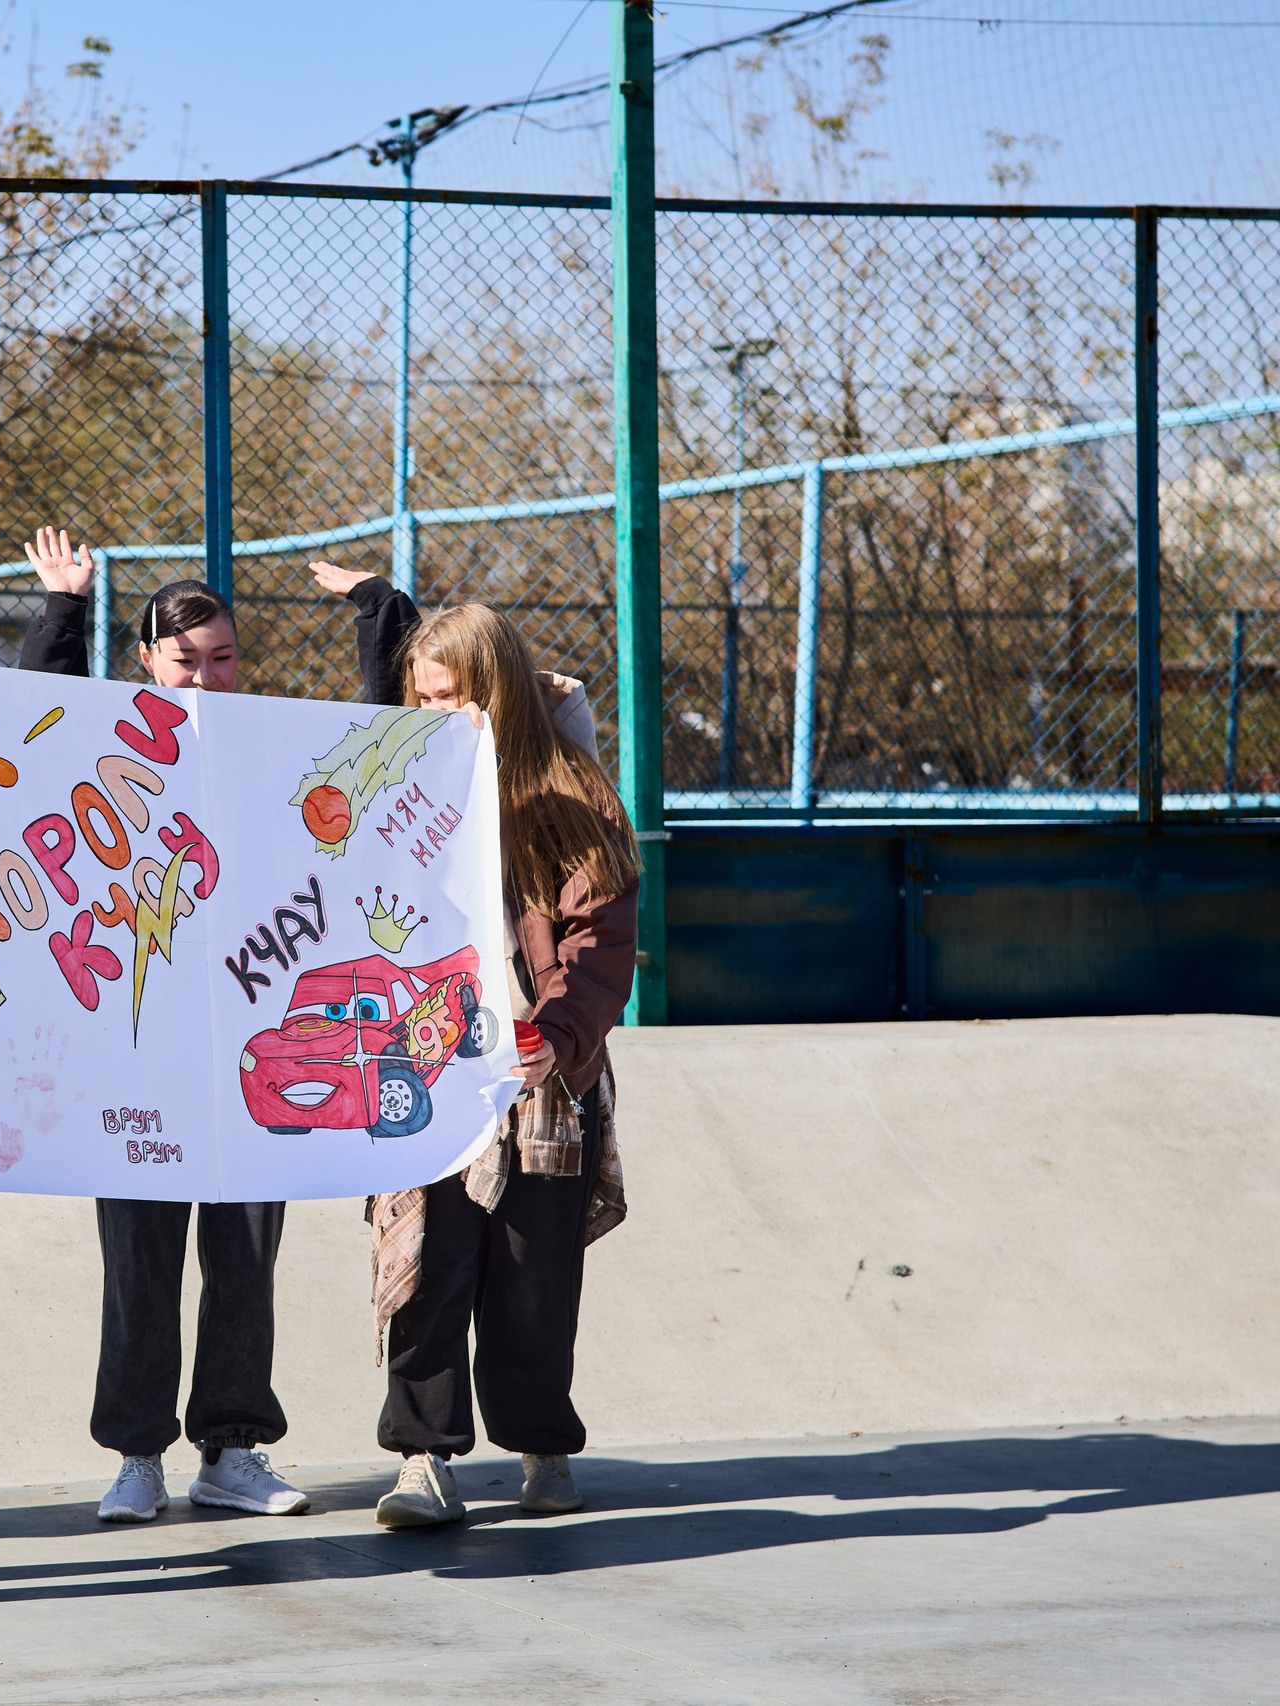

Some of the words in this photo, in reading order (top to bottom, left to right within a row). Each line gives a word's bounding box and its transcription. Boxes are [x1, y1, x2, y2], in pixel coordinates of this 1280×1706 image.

[376, 782, 435, 848] МЯЧ
[409, 803, 463, 868] НАШ
[49, 811, 220, 1012] КЧАУ
[224, 873, 329, 1005] КЧАУ
[412, 1003, 460, 1063] 95
[102, 1106, 163, 1135] ВРУМ
[126, 1139, 183, 1164] ВРУМ
